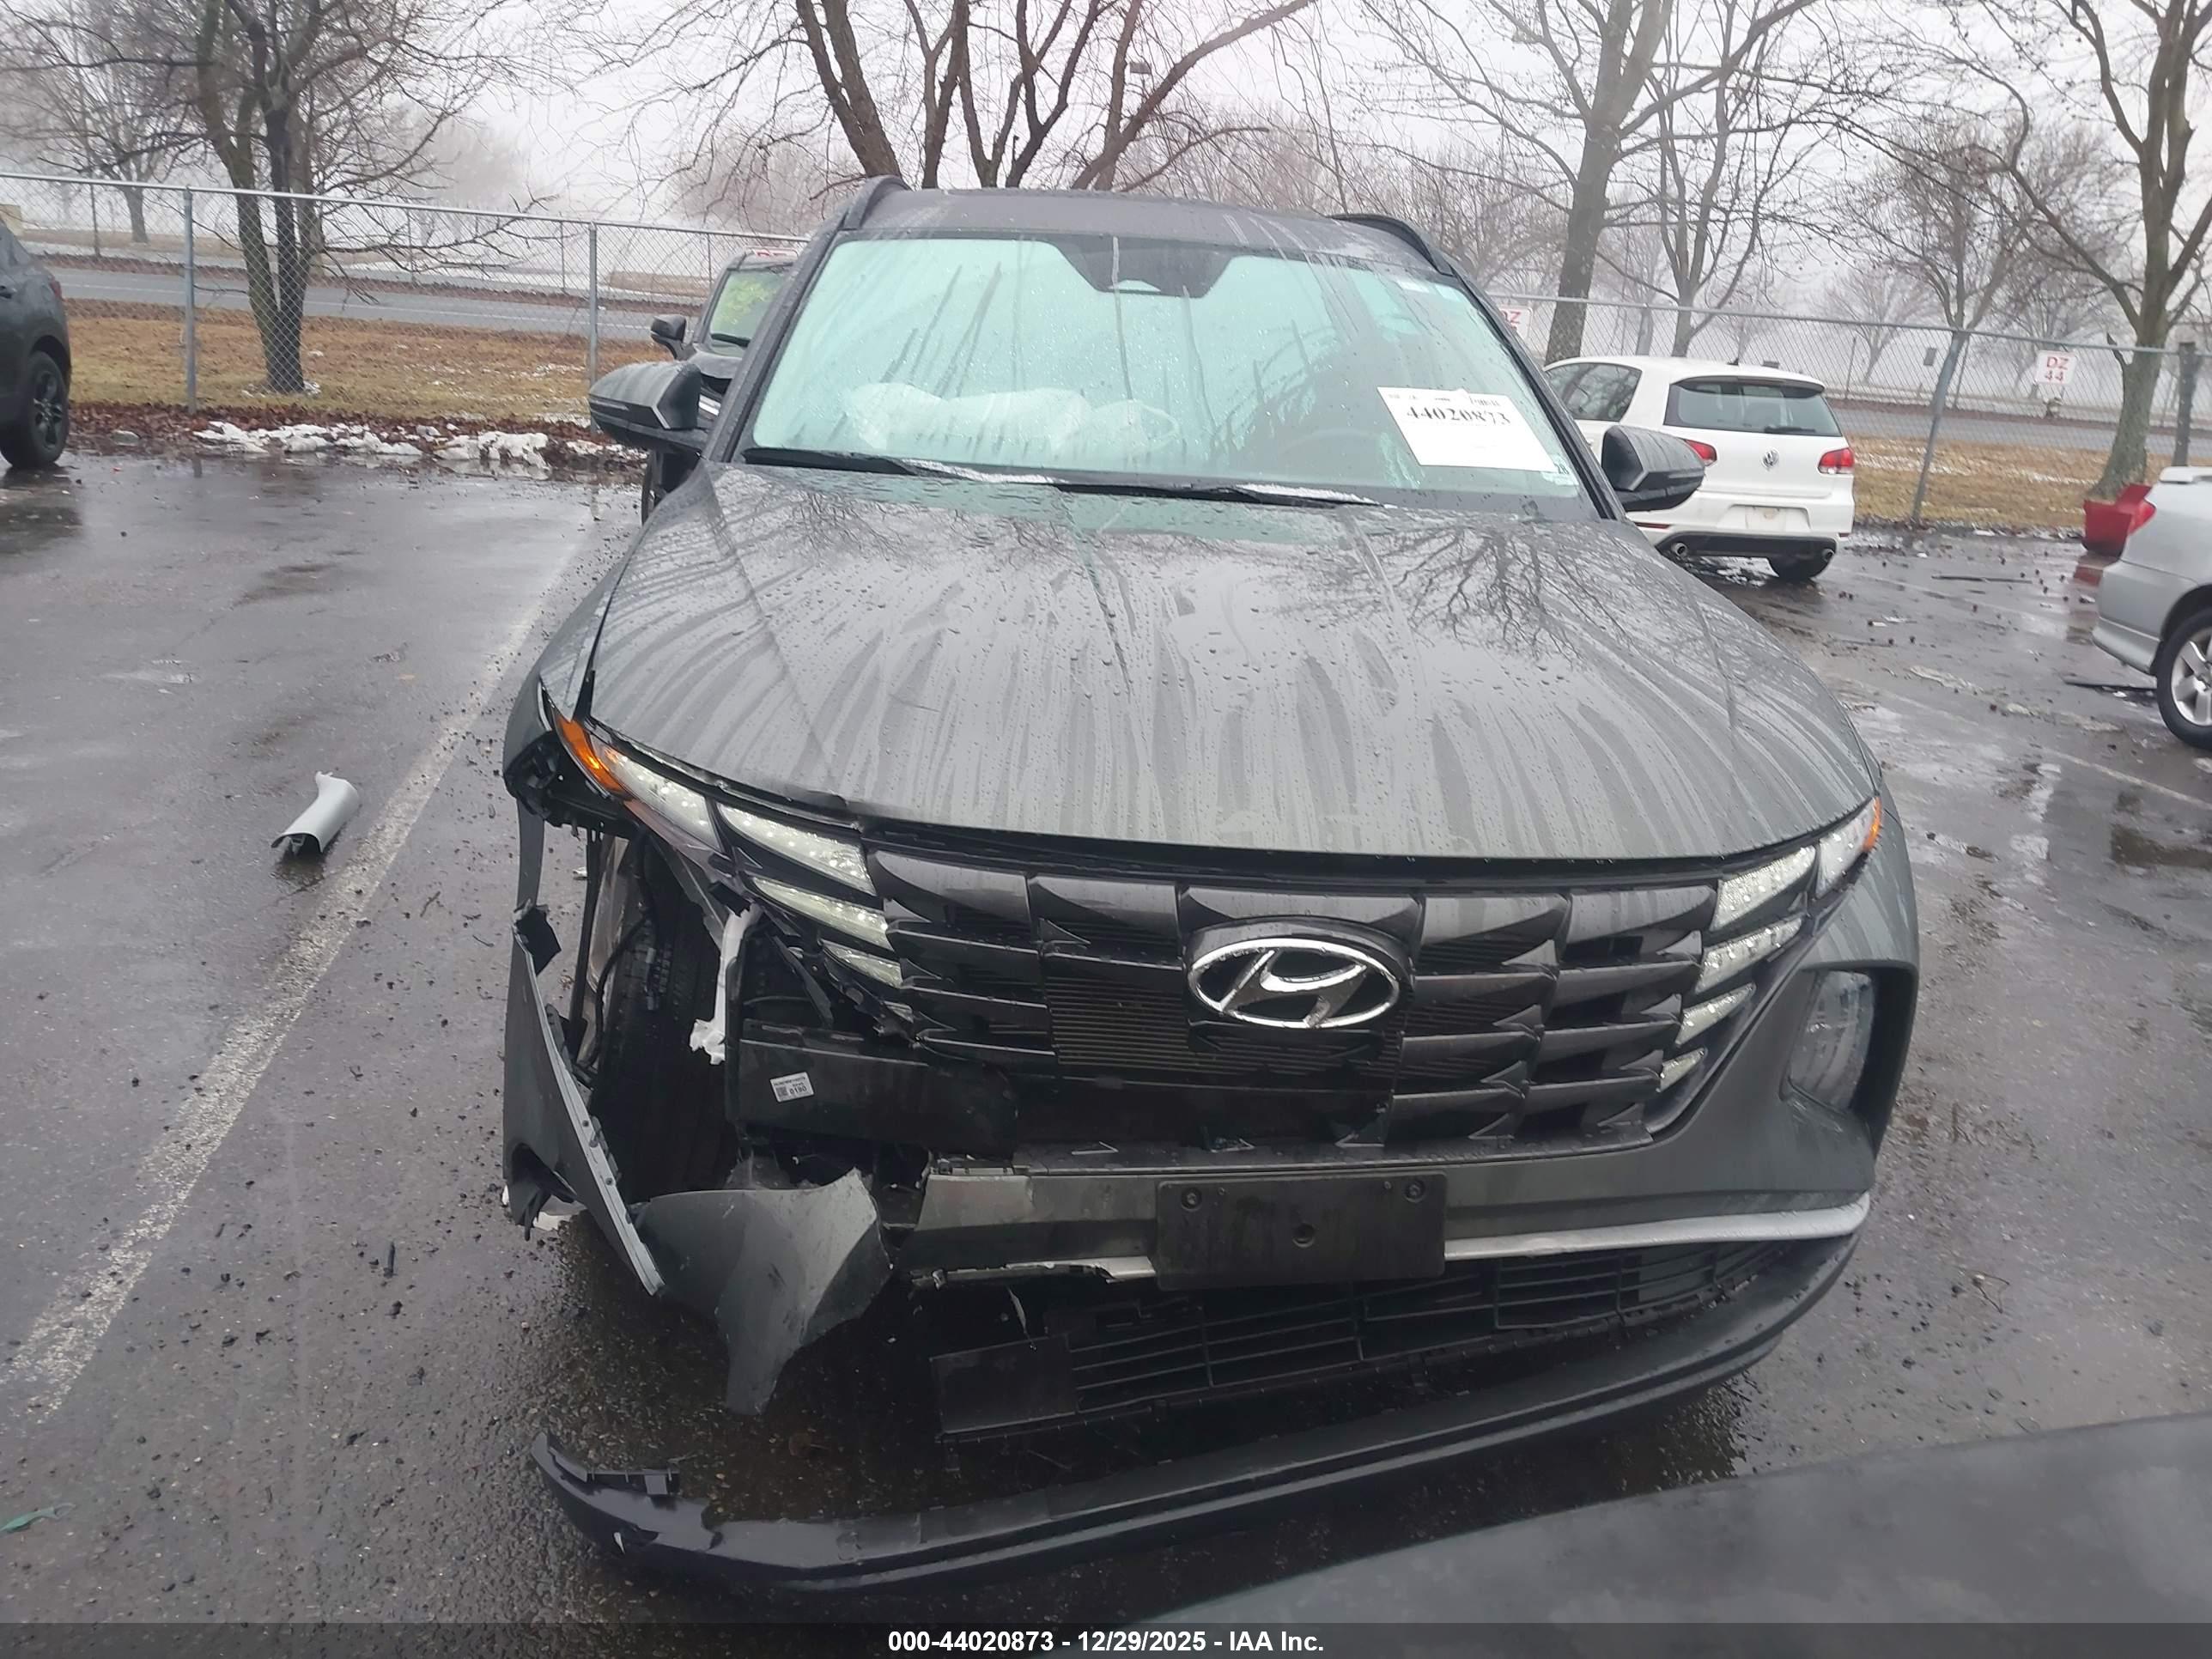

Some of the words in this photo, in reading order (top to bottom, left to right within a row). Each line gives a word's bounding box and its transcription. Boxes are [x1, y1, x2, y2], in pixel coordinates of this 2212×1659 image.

[2046, 356, 2069, 371] DZ
[2045, 370, 2063, 381] 44
[1406, 406, 1511, 425] 44020873
